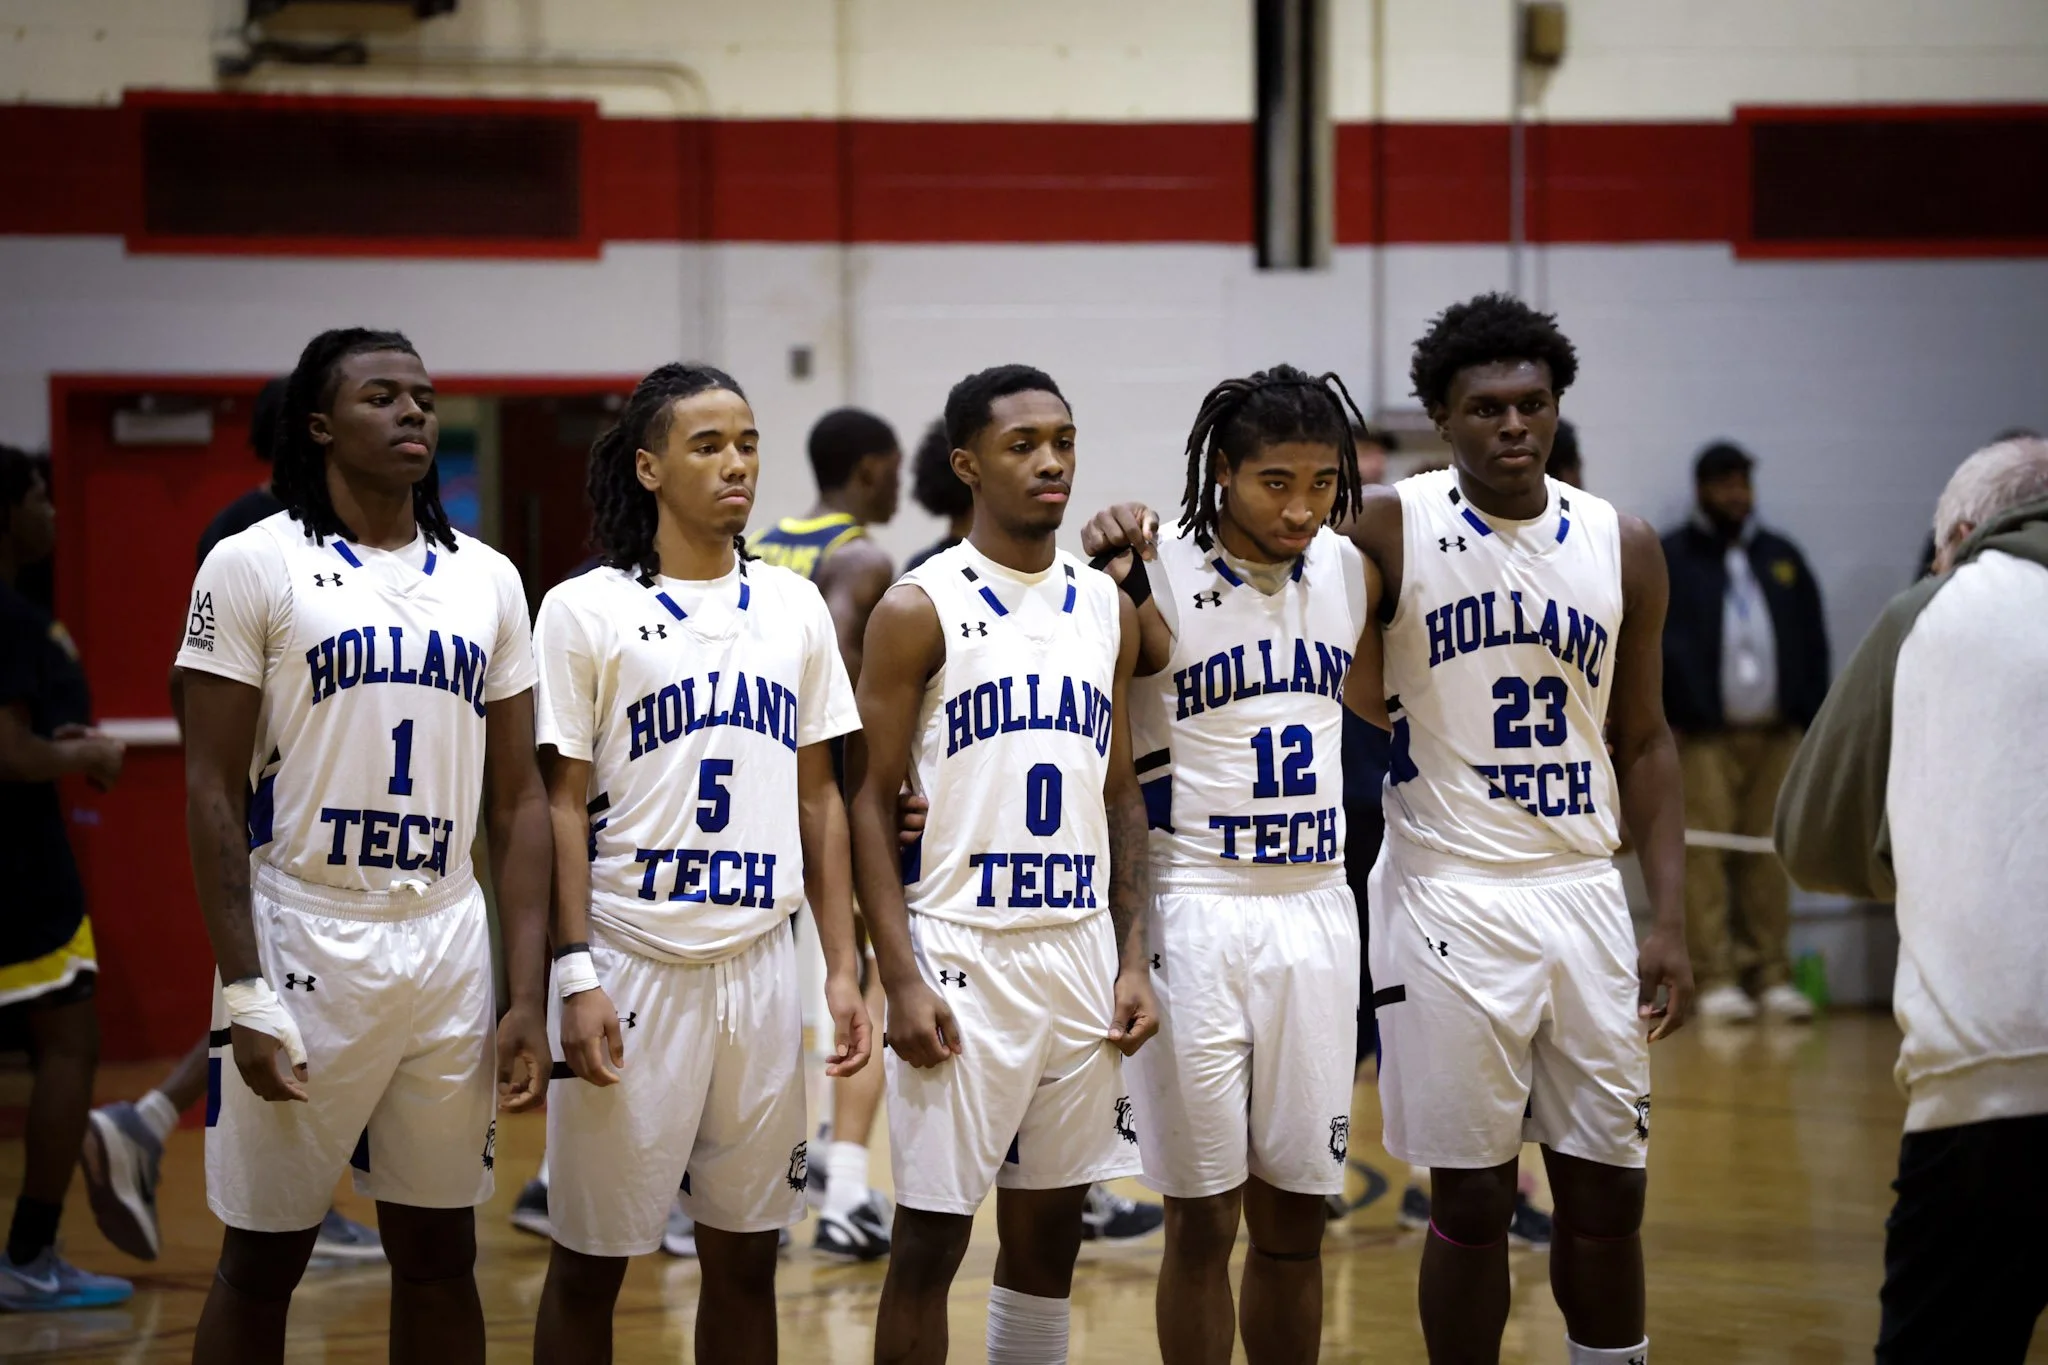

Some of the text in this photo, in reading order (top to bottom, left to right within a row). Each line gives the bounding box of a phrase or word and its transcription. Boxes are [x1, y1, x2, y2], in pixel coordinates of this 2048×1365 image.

[187, 636, 214, 652] HOOPS
[1426, 592, 1607, 688] HOLLAND
[627, 672, 797, 761] HOLLAND
[946, 675, 1112, 758] HOLLAND
[1493, 677, 1567, 748] 23
[389, 720, 413, 795] 1
[1251, 725, 1316, 798] 12
[697, 759, 733, 832] 5
[1026, 764, 1062, 836] 0
[321, 808, 452, 876] TECH
[1209, 808, 1336, 864] TECH
[635, 849, 775, 908] TECH
[970, 854, 1096, 908] TECH
